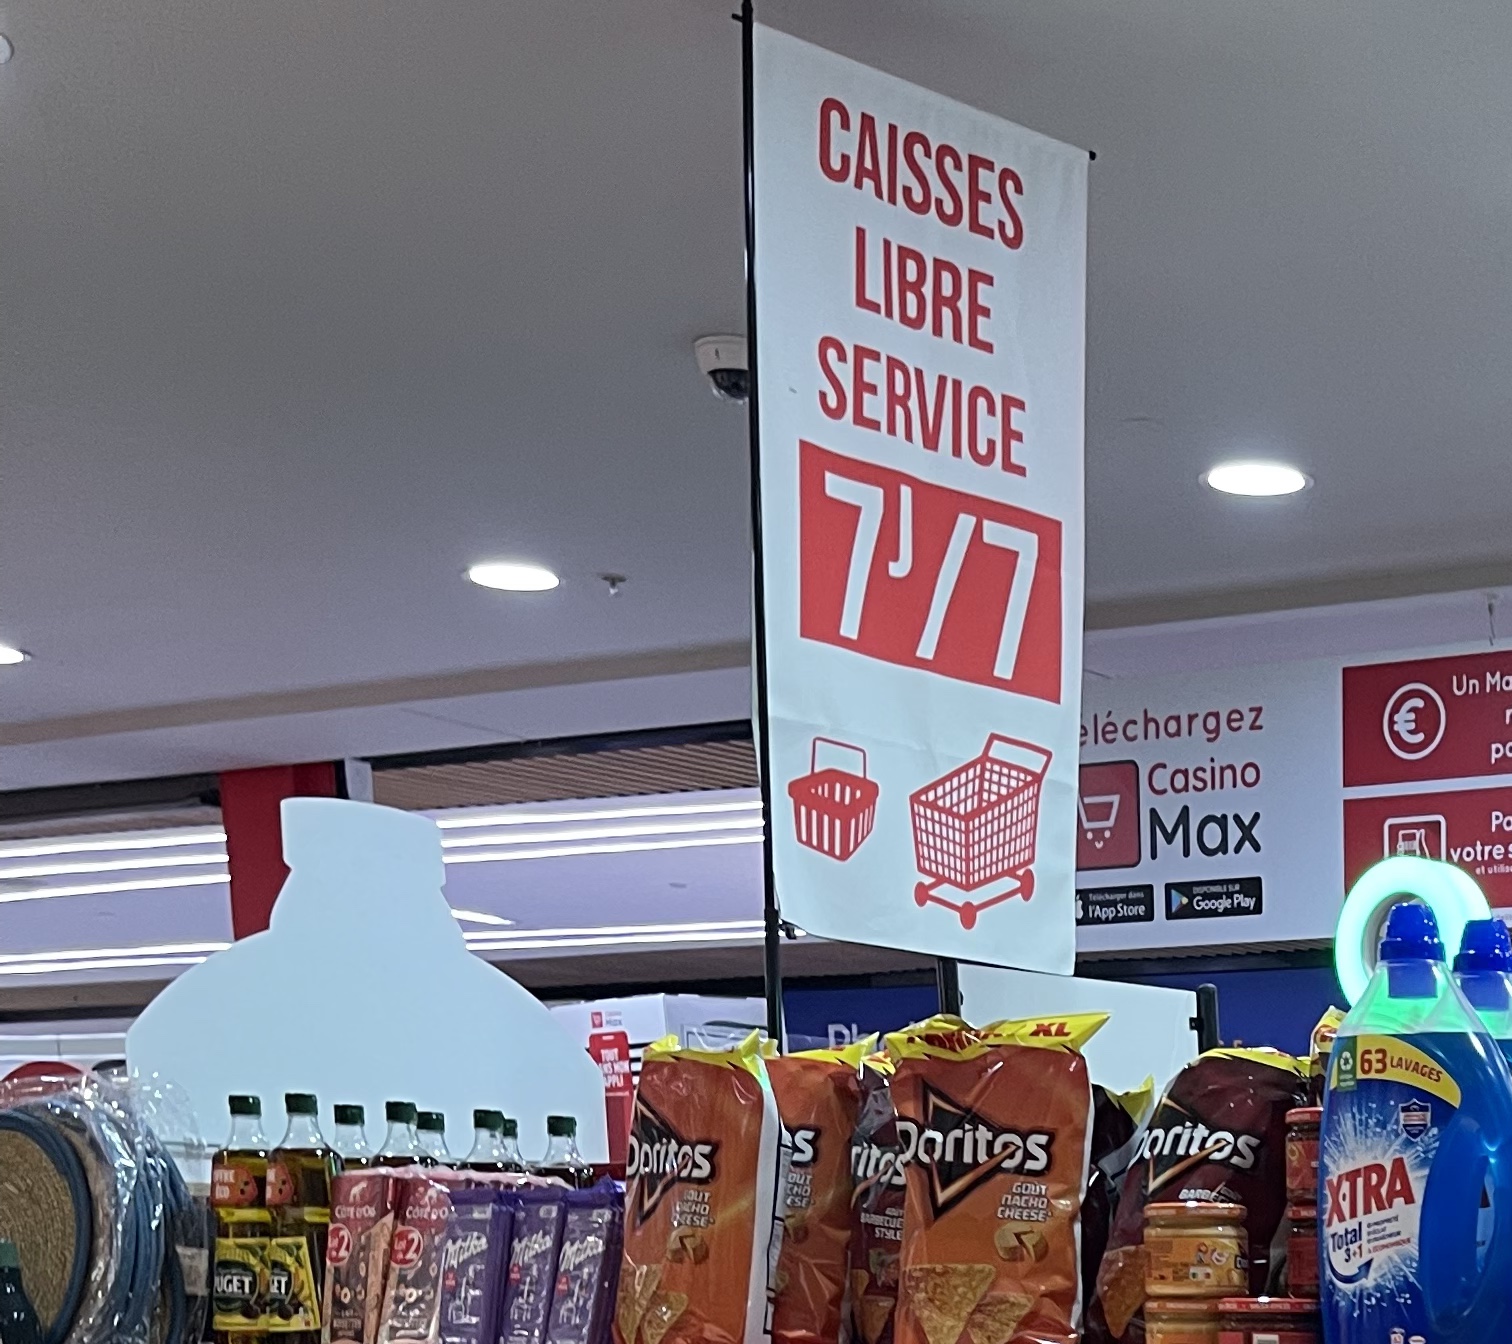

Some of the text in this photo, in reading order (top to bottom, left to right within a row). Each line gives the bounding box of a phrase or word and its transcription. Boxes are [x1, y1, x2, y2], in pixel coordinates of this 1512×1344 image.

[817, 95, 1024, 250] CAISSES
[853, 225, 995, 355] LIBRE
[817, 334, 1027, 478] SERVICE
[1451, 672, 1480, 697] Un
[1080, 706, 1264, 747] léchargez
[1148, 757, 1261, 795] Casino
[1149, 804, 1261, 861] Max
[1450, 840, 1505, 863] votre
[1088, 903, 1146, 920] l'App Store
[1192, 894, 1256, 913] Google Play
[1029, 1021, 1073, 1039] XL
[1360, 1048, 1443, 1083] 63 LAVAGES
[1002, 1195, 1048, 1208] NACHO
[443, 1232, 488, 1268] Milka
[510, 1231, 553, 1266] Milka
[560, 1236, 606, 1272] Milka
[1330, 1221, 1363, 1252] Total
